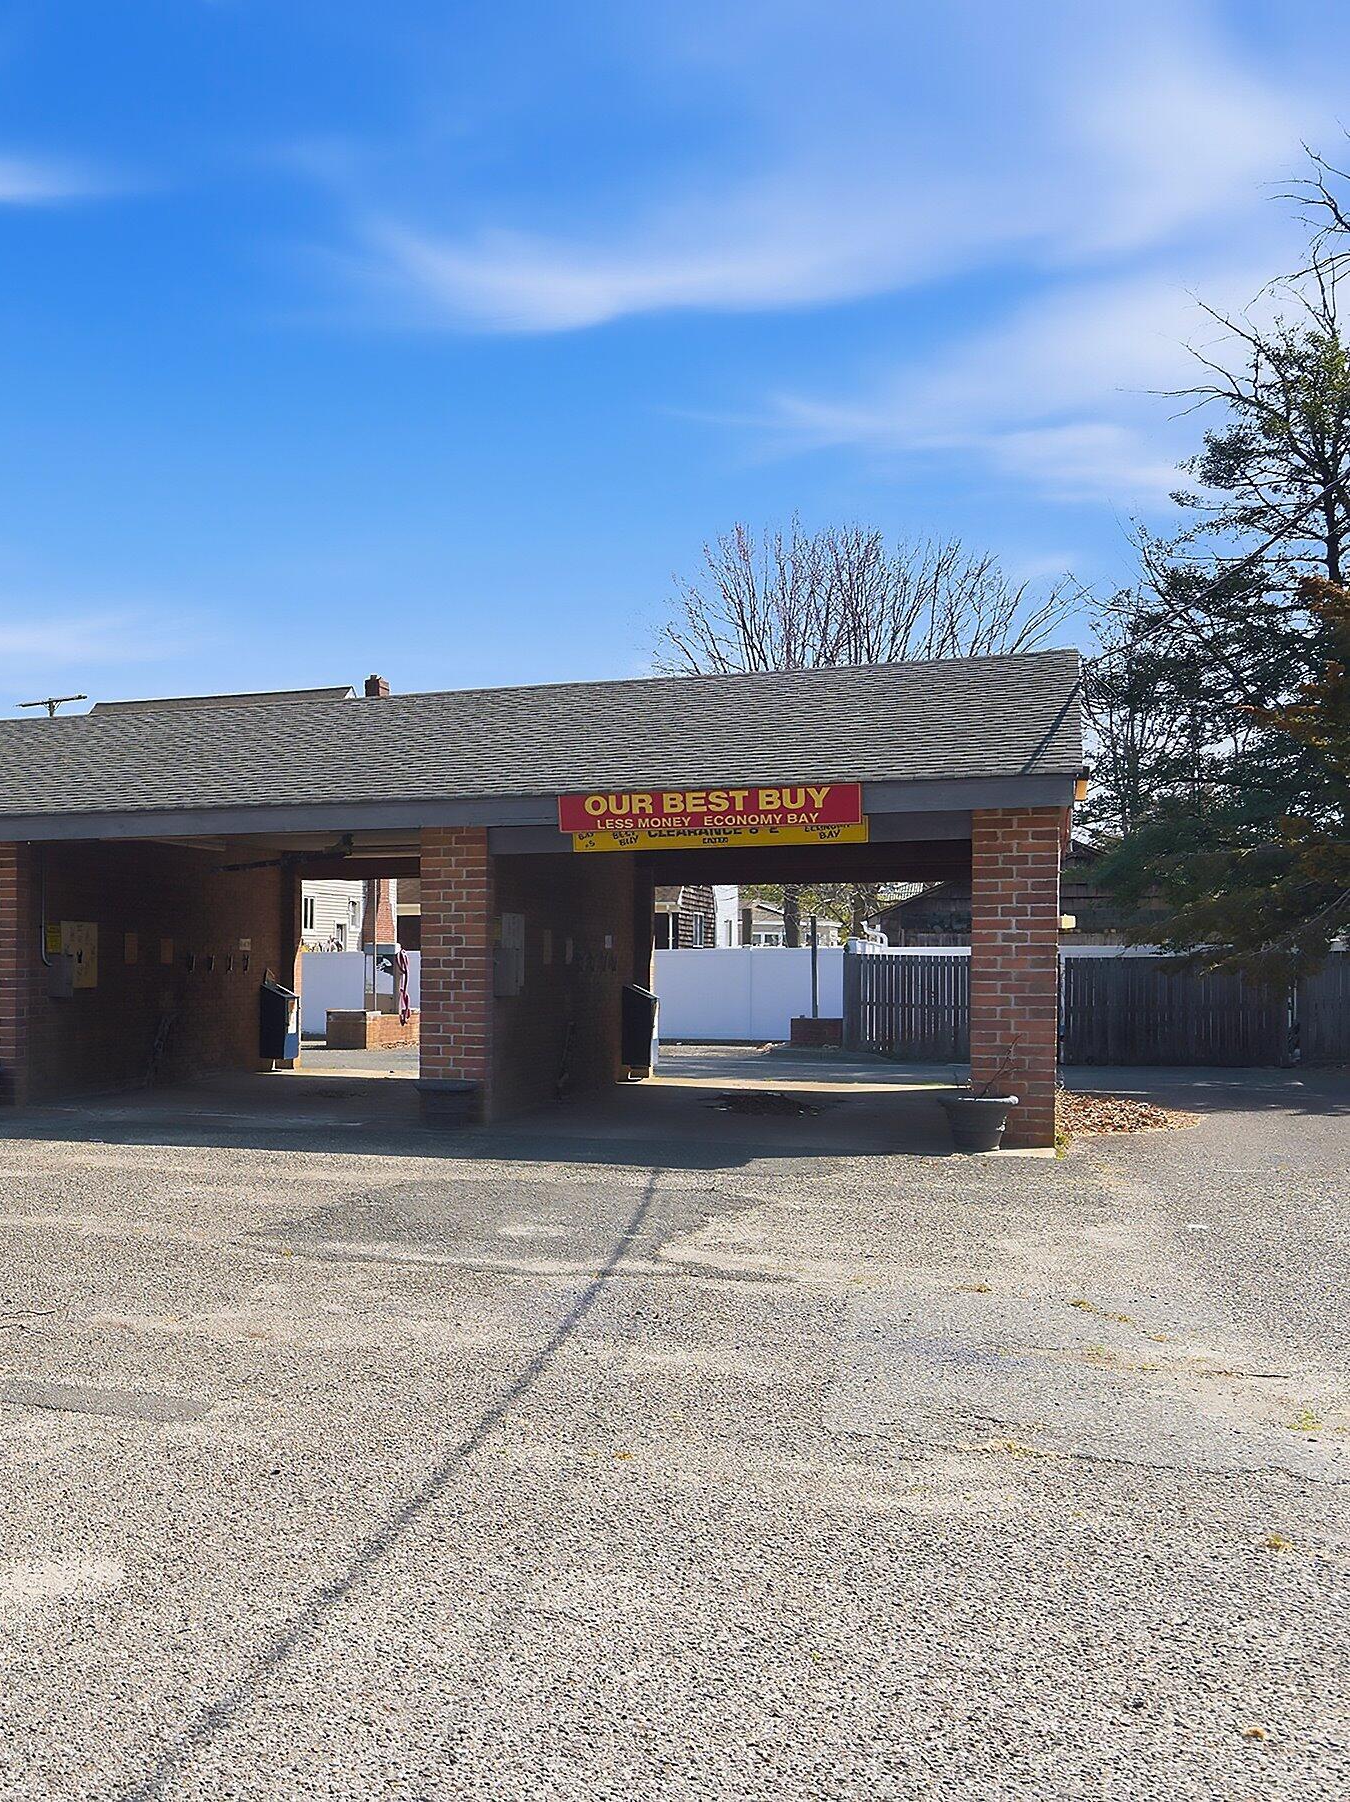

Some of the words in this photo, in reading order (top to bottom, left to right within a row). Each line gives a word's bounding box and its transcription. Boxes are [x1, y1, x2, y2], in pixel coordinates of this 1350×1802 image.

[584, 793, 653, 816] OUR
[663, 790, 749, 813] BEST
[759, 787, 831, 810] BUY
[597, 818, 634, 830] LESS
[637, 816, 691, 829] MONEY
[704, 814, 781, 827] ECONOMY
[787, 812, 819, 824] BAY
[819, 830, 841, 840] BAY
